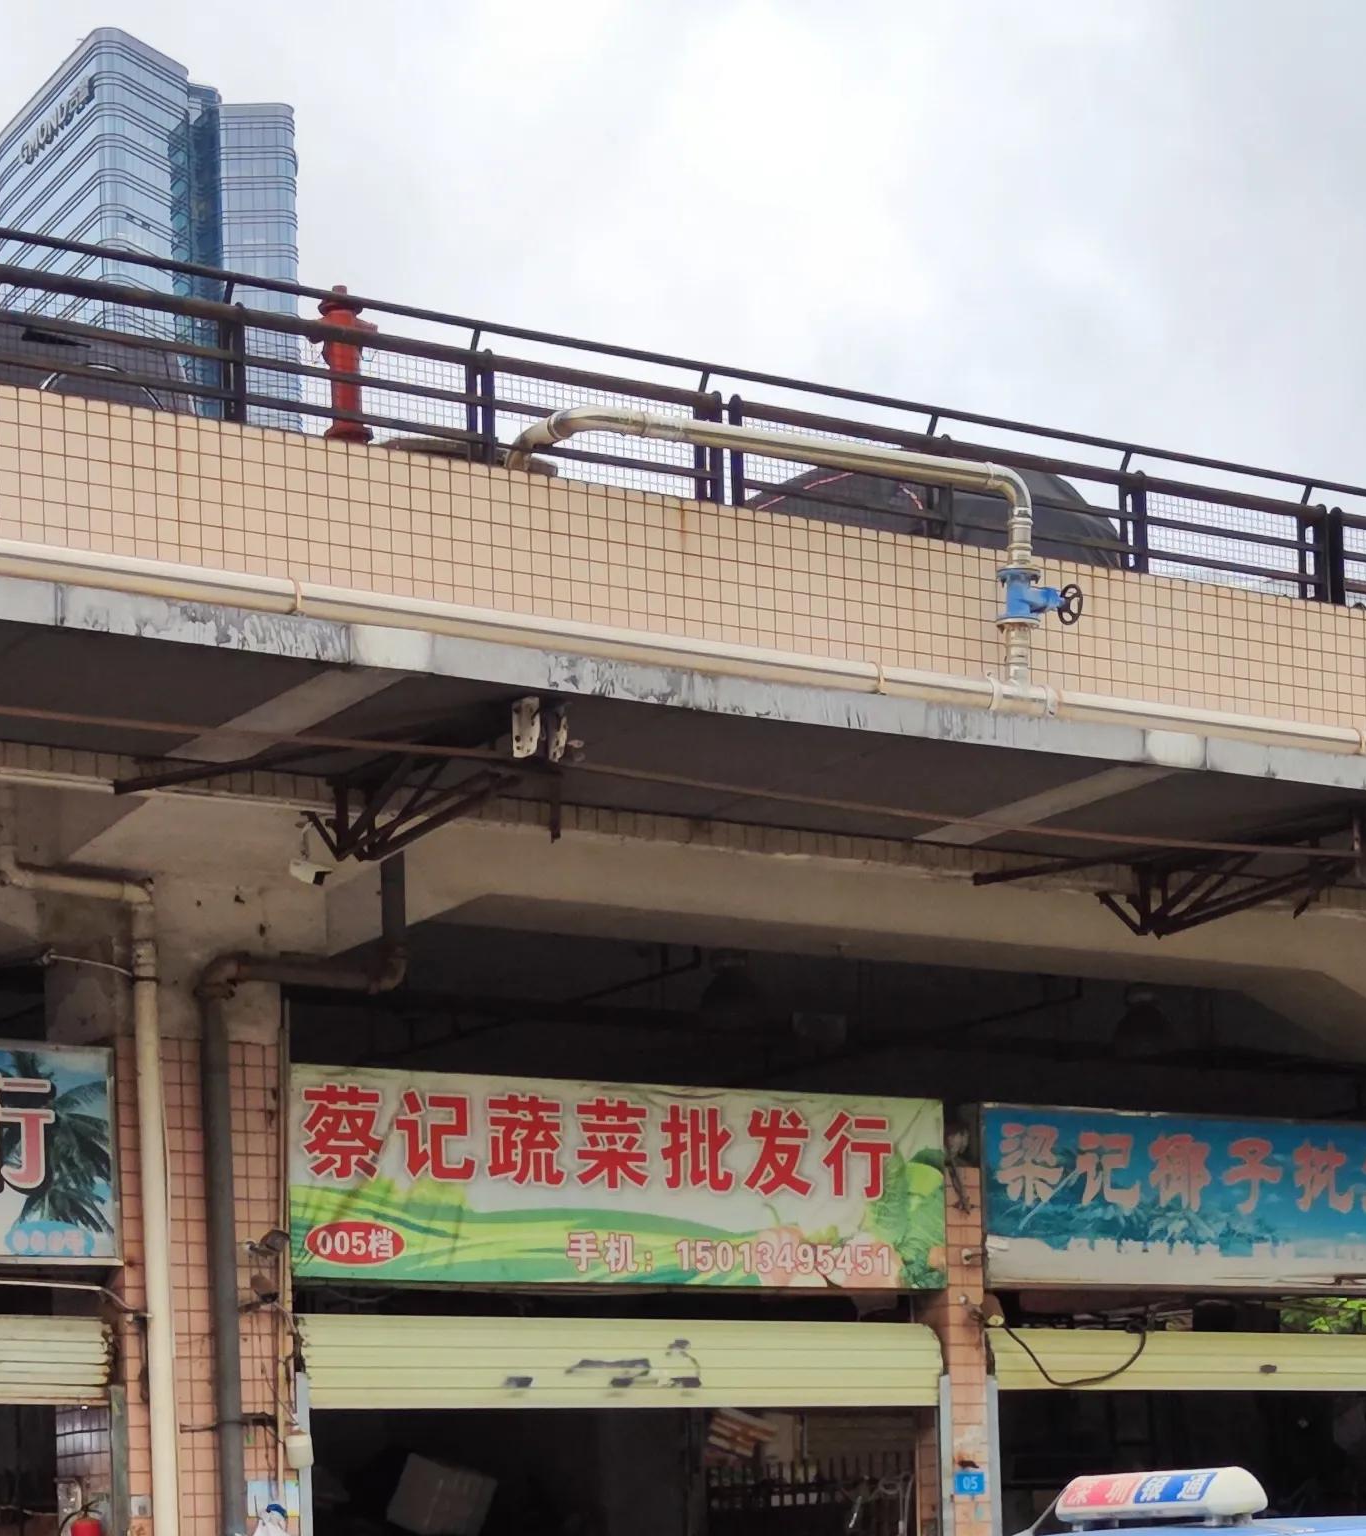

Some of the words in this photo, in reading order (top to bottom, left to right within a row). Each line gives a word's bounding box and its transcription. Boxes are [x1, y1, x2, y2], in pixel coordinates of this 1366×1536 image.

[302, 1082, 894, 1202] 蔡记蔬菜批发行
[316, 1227, 396, 1261] 005档
[962, 1475, 979, 1491] 05
